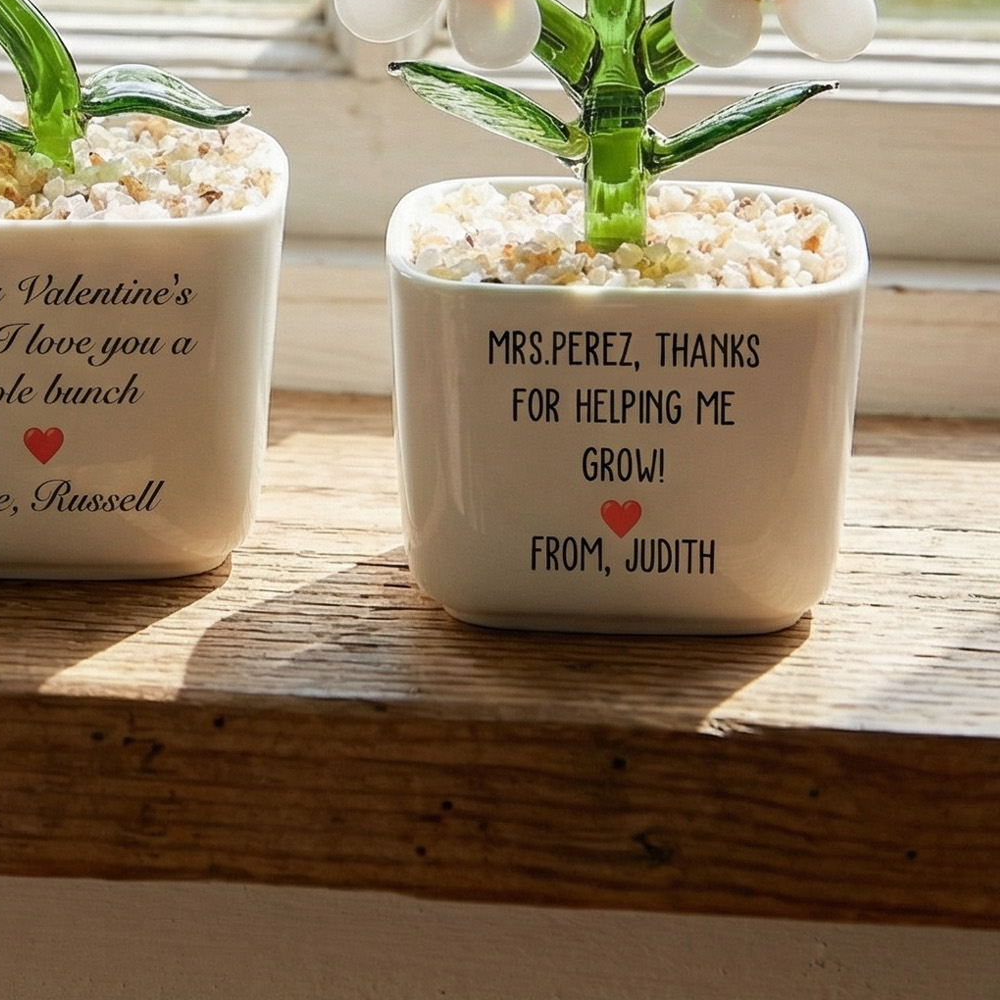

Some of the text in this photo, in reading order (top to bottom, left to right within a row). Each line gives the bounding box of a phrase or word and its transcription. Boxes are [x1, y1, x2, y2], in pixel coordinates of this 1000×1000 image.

[17, 273, 197, 306] Valentine's
[26, 323, 97, 355] love
[88, 336, 166, 366] you
[171, 338, 198, 355] a
[488, 330, 760, 372] MRS.PEREZ, THANKS
[43, 373, 144, 405] bunch
[512, 387, 736, 426] FOR HELPING ME
[582, 446, 665, 483] GROW!
[30, 479, 165, 512] Russell
[531, 535, 715, 577] FROM, JUDITH
